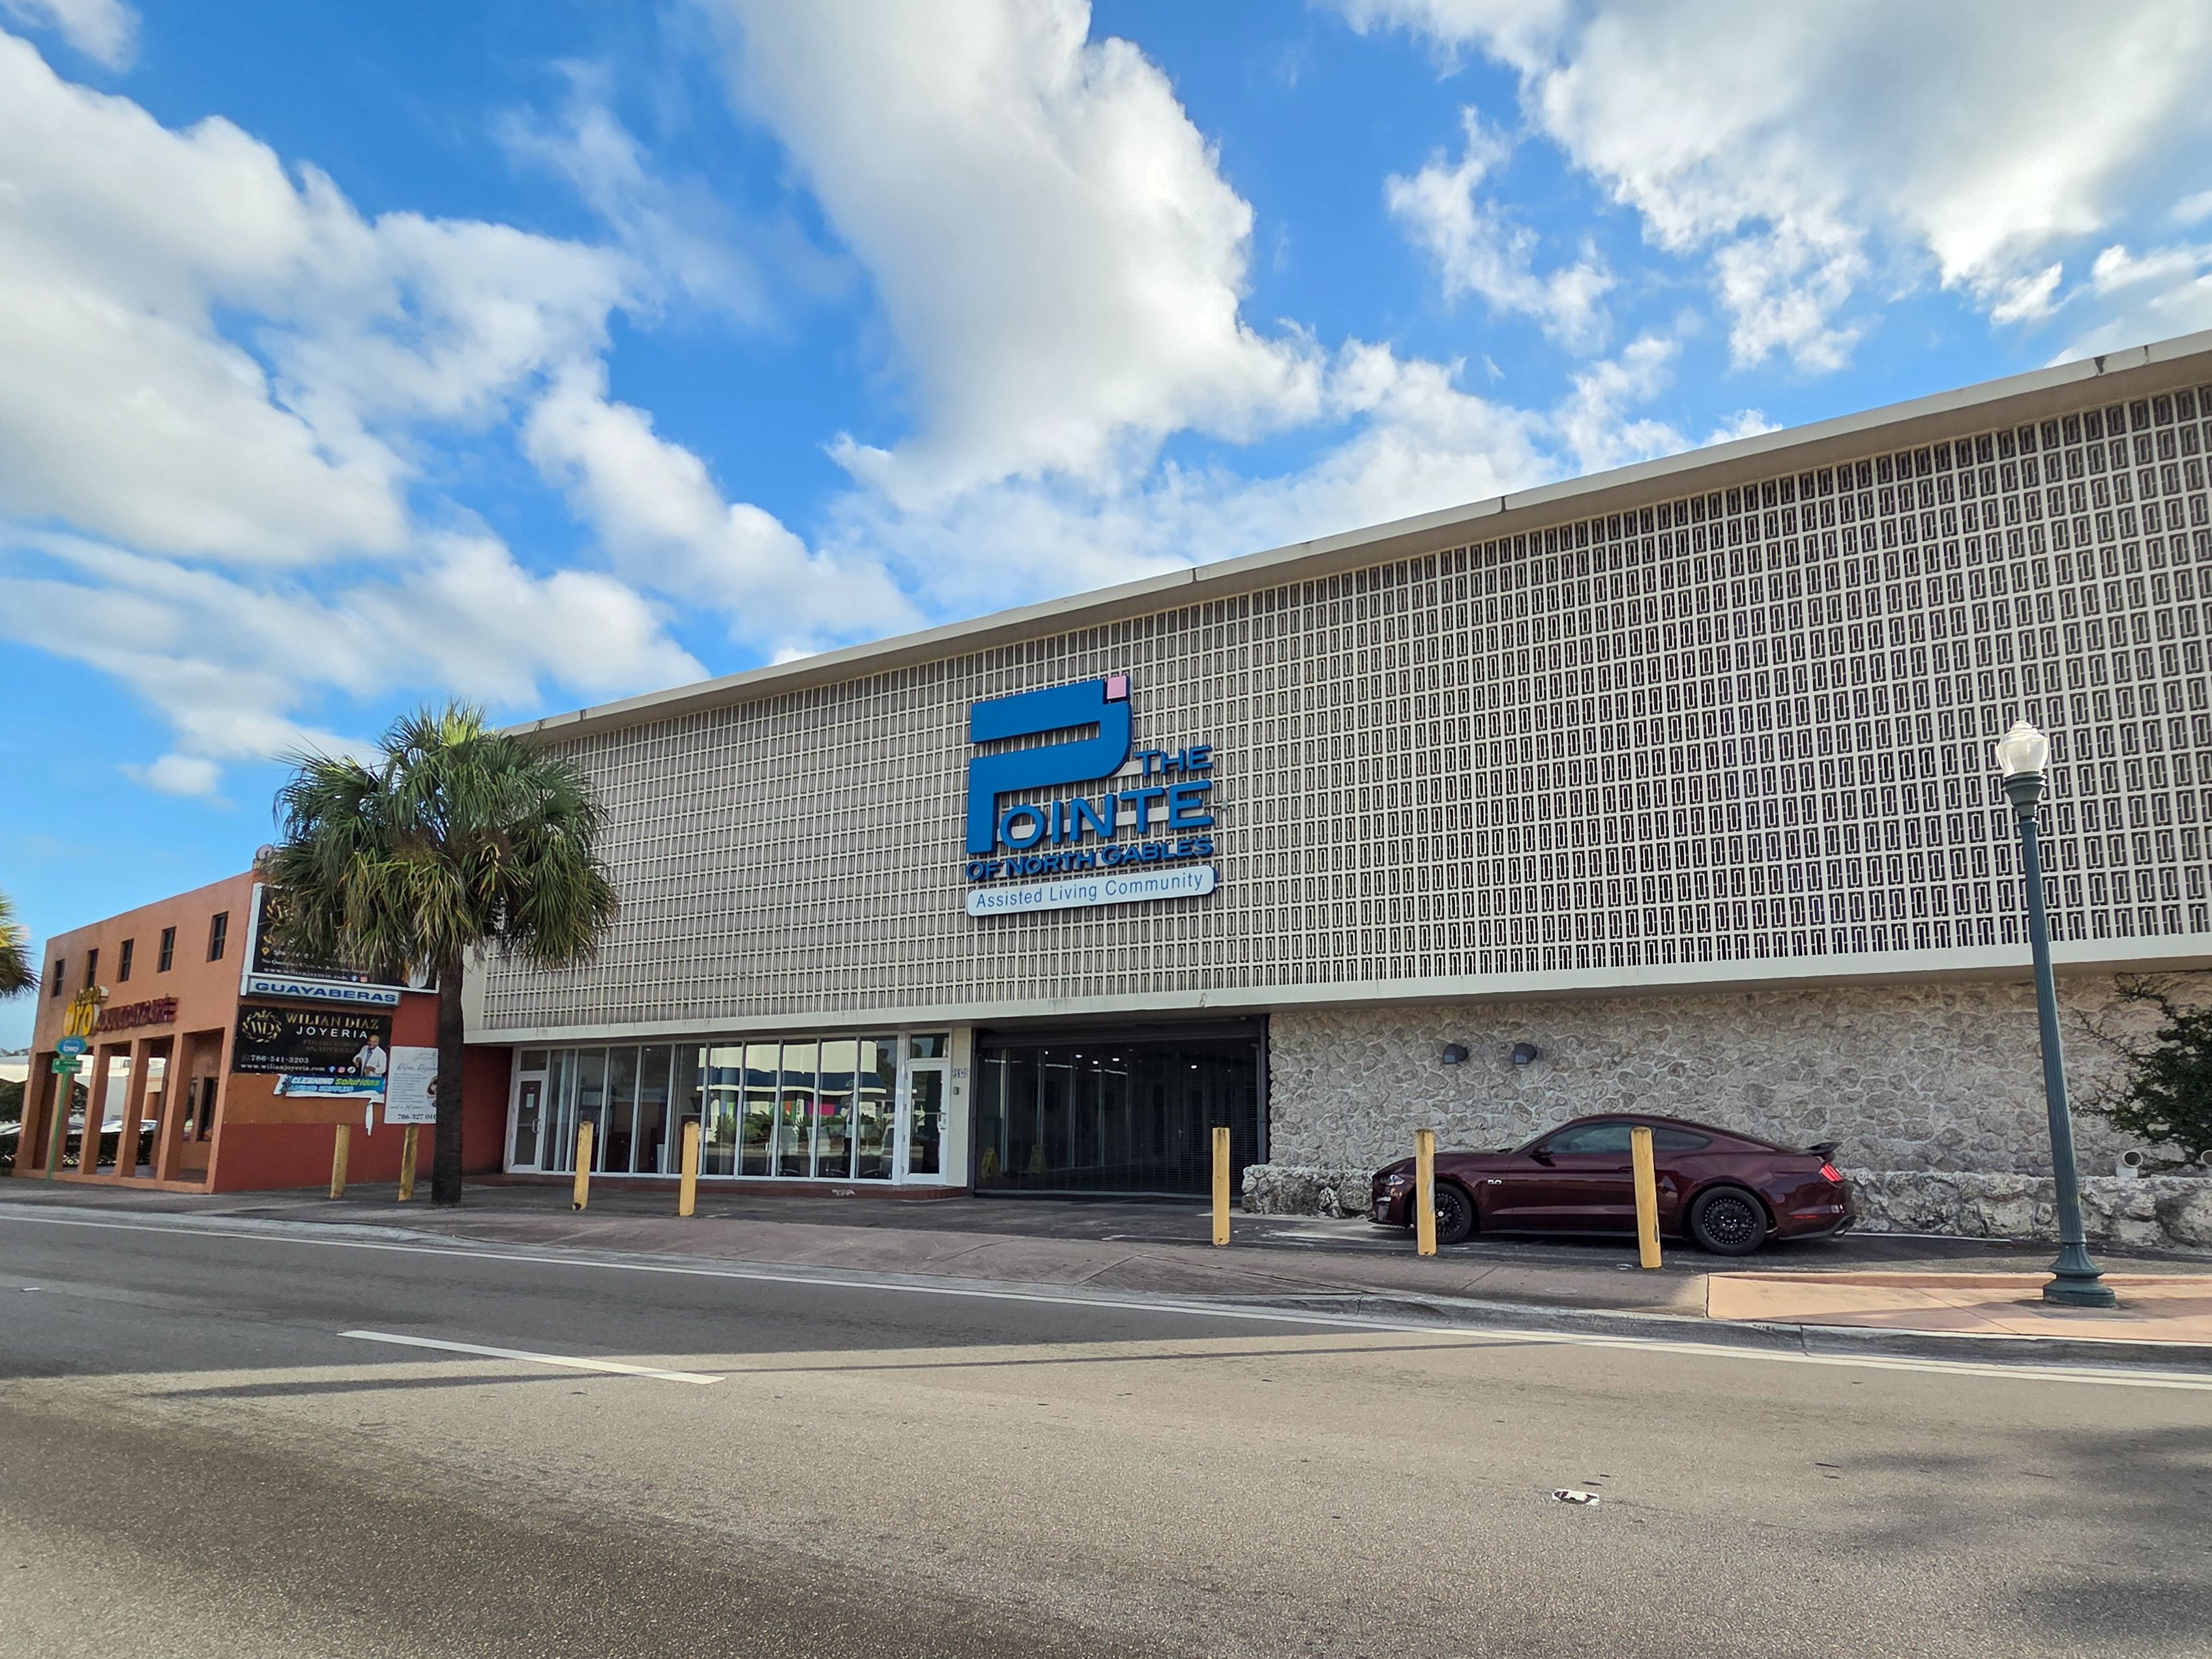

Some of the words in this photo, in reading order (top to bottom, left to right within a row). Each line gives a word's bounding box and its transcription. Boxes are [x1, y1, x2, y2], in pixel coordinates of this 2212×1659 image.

[966, 677, 1215, 854] POINTE
[1134, 745, 1214, 778] THE
[966, 860, 1005, 881] OF
[1005, 850, 1096, 877] NORTH
[1100, 836, 1214, 867] GABLES
[976, 888, 1042, 909] Assisted
[1050, 881, 1098, 902] Living
[1104, 872, 1203, 896] Community
[255, 982, 396, 1003] GUAYABERAS
[286, 1012, 342, 1027] WILIAN
[345, 1017, 379, 1030] DIAZ
[296, 1026, 368, 1039] JOYERIA
[250, 1054, 310, 1064] 786-541-3203
